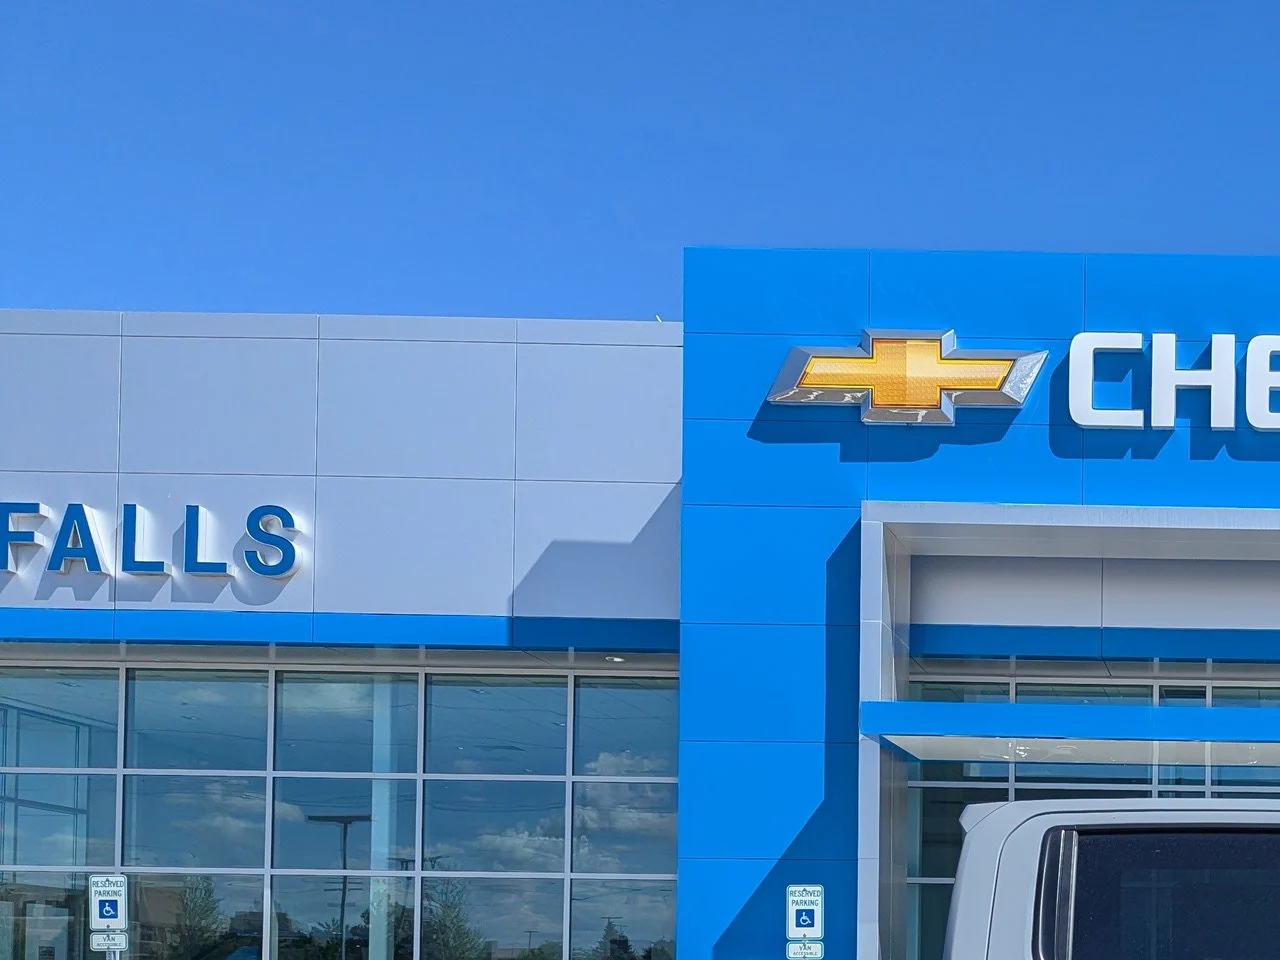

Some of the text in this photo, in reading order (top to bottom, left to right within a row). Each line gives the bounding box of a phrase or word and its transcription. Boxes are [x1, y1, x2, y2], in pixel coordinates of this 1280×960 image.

[0, 502, 298, 577] FALLS
[92, 880, 124, 888] RESERVED
[94, 889, 122, 897] PARKING
[789, 889, 821, 898] RESERVED
[791, 899, 819, 907] PARKING
